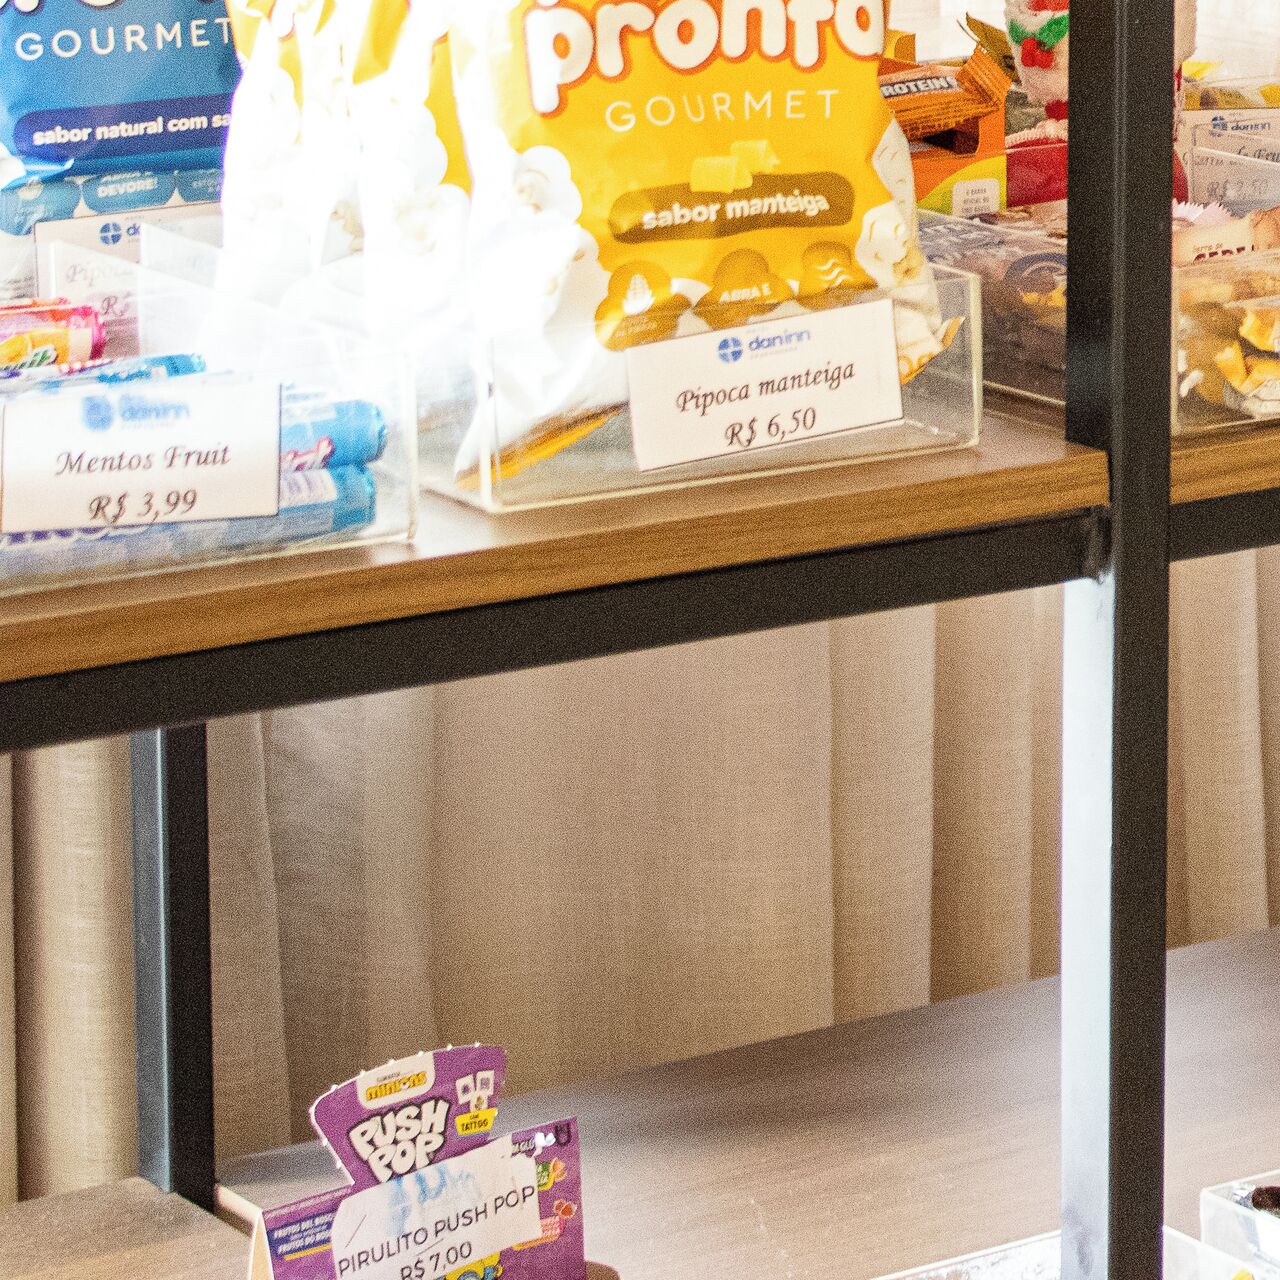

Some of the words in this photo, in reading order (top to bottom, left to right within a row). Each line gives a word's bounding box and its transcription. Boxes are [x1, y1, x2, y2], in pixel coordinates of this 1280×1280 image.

[32, 125, 92, 146] sabor
[95, 116, 164, 141] natural
[167, 113, 208, 133] com
[605, 89, 840, 135] GOURMET
[642, 200, 721, 231] sabor
[724, 189, 831, 226] manteiga
[747, 329, 811, 352] daninn
[676, 384, 751, 417] Pipoca
[758, 361, 856, 397] manteiga
[725, 418, 758, 448] R$
[766, 407, 818, 443] 6,50
[54, 445, 153, 477] Mentos
[164, 443, 231, 469] Fruit
[88, 492, 128, 525] R$
[138, 489, 199, 523] 3,99
[349, 1099, 450, 1161] PUSH
[461, 1119, 489, 1133] TATTOO
[367, 1133, 445, 1183] POP
[336, 1226, 430, 1279] PIRULITO
[433, 1202, 488, 1240] PUSH
[494, 1185, 535, 1215] POP
